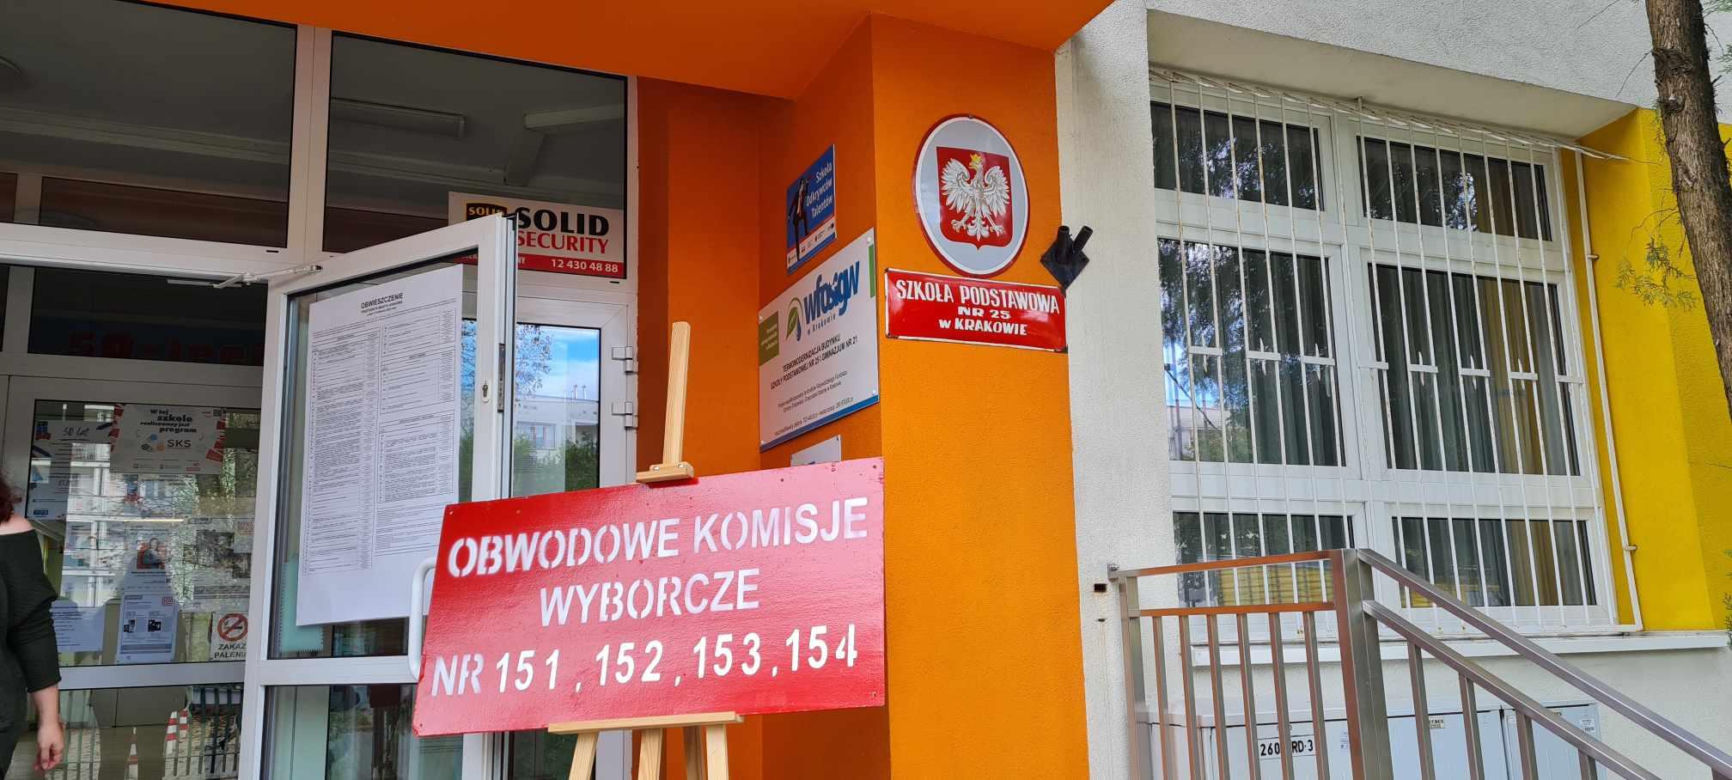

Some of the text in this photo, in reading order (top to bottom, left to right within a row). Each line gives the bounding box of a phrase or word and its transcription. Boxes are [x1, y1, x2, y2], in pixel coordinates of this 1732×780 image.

[515, 207, 609, 236] SOLID
[517, 230, 609, 254] SECURITY
[551, 258, 619, 273] 12 430 48 88
[361, 292, 404, 309] OBWIESZCZENIE
[896, 279, 1060, 314] SZKOŁA PODSTAWOWA
[958, 306, 1011, 319] NR 25
[954, 318, 1028, 336] KRAKOWIE
[159, 426, 197, 435] program
[168, 439, 191, 448] SKS
[447, 518, 680, 577] OBWODOWE
[693, 497, 868, 553] KOMISJE
[540, 568, 760, 627] WYBORCZE
[431, 653, 484, 697] NR
[785, 623, 858, 672] 154
